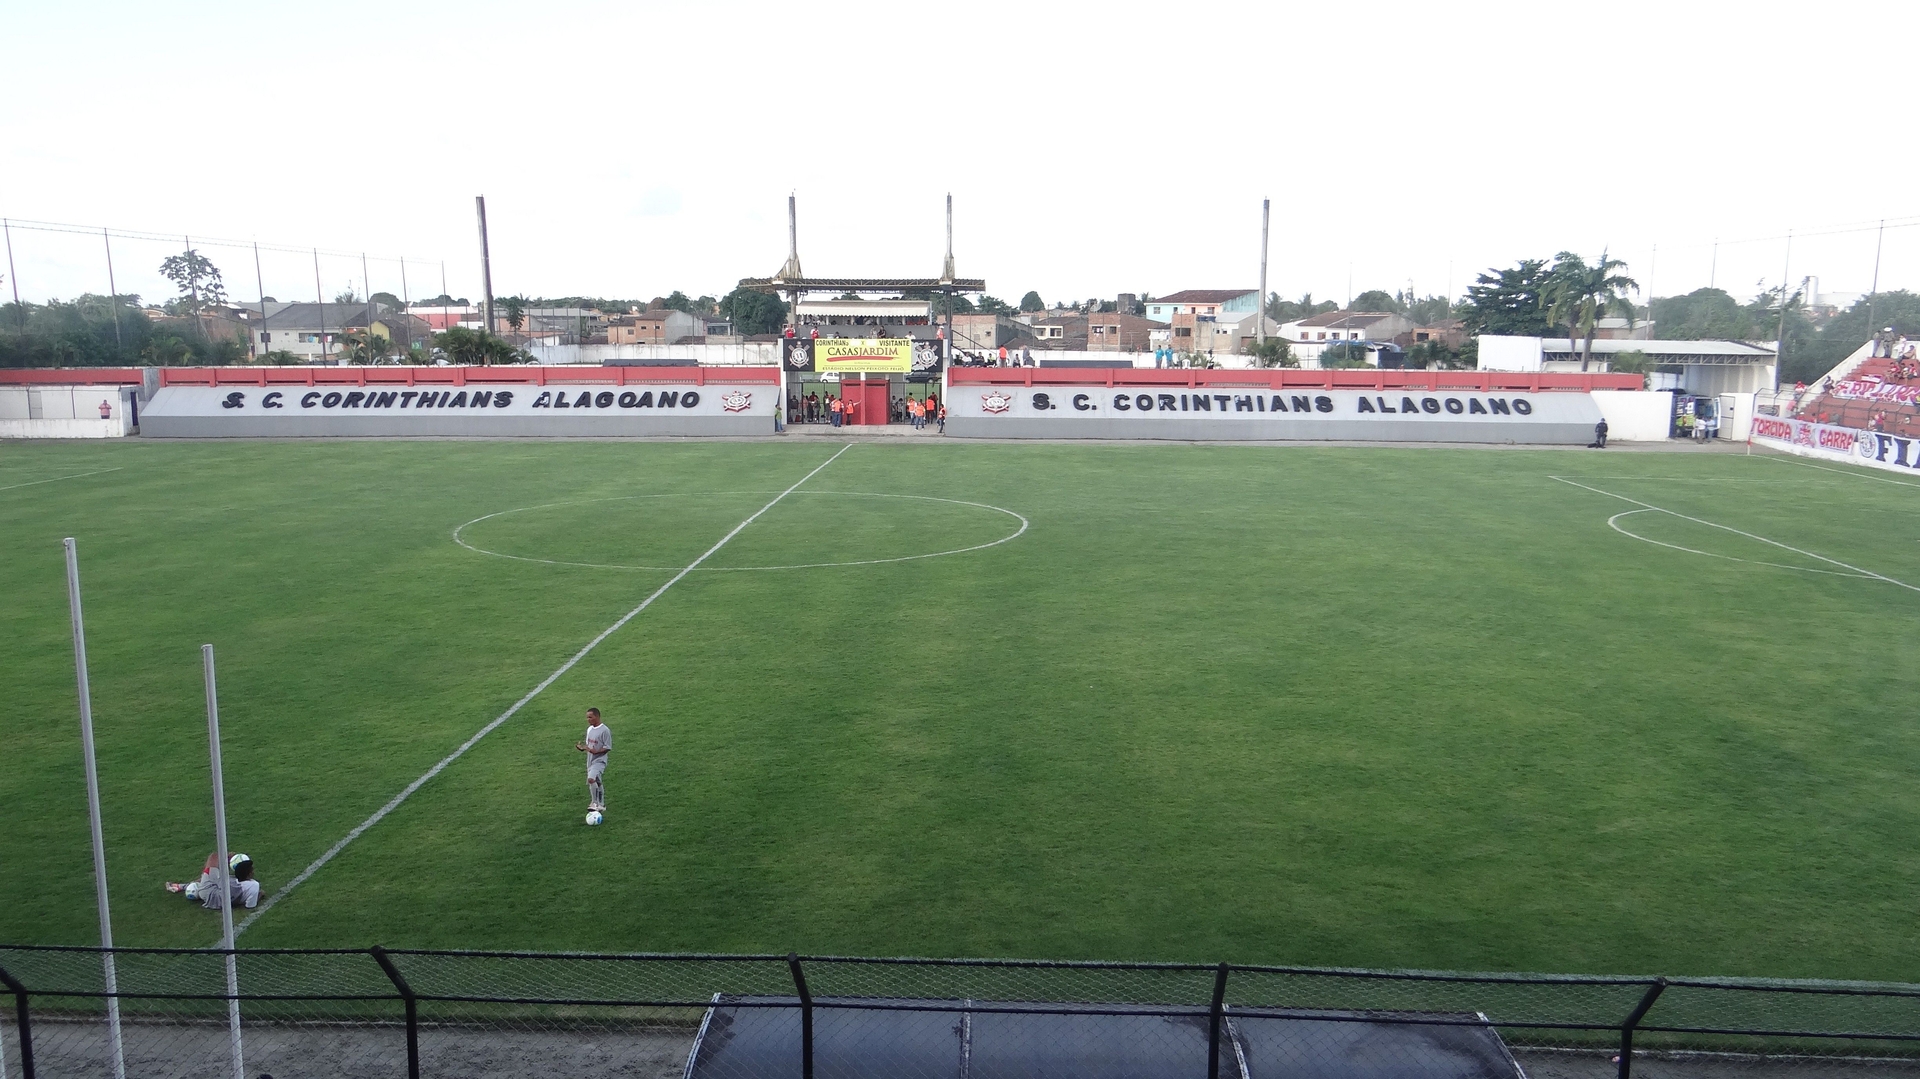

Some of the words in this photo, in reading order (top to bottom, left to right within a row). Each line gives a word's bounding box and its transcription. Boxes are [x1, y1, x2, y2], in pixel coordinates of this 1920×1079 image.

[879, 339, 910, 347] VISITANTE
[222, 392, 244, 409] S.
[262, 392, 283, 409] C.
[300, 392, 513, 409] CORINTHIANS
[532, 391, 700, 408] ALAGOANO
[1032, 393, 1056, 410] S.
[1073, 394, 1097, 411] C.
[1114, 394, 1334, 413] CORINTHIANS
[1357, 396, 1532, 415] ALAGOANO
[1750, 417, 1792, 439] TORCIDA
[1874, 433, 1920, 469] FI
